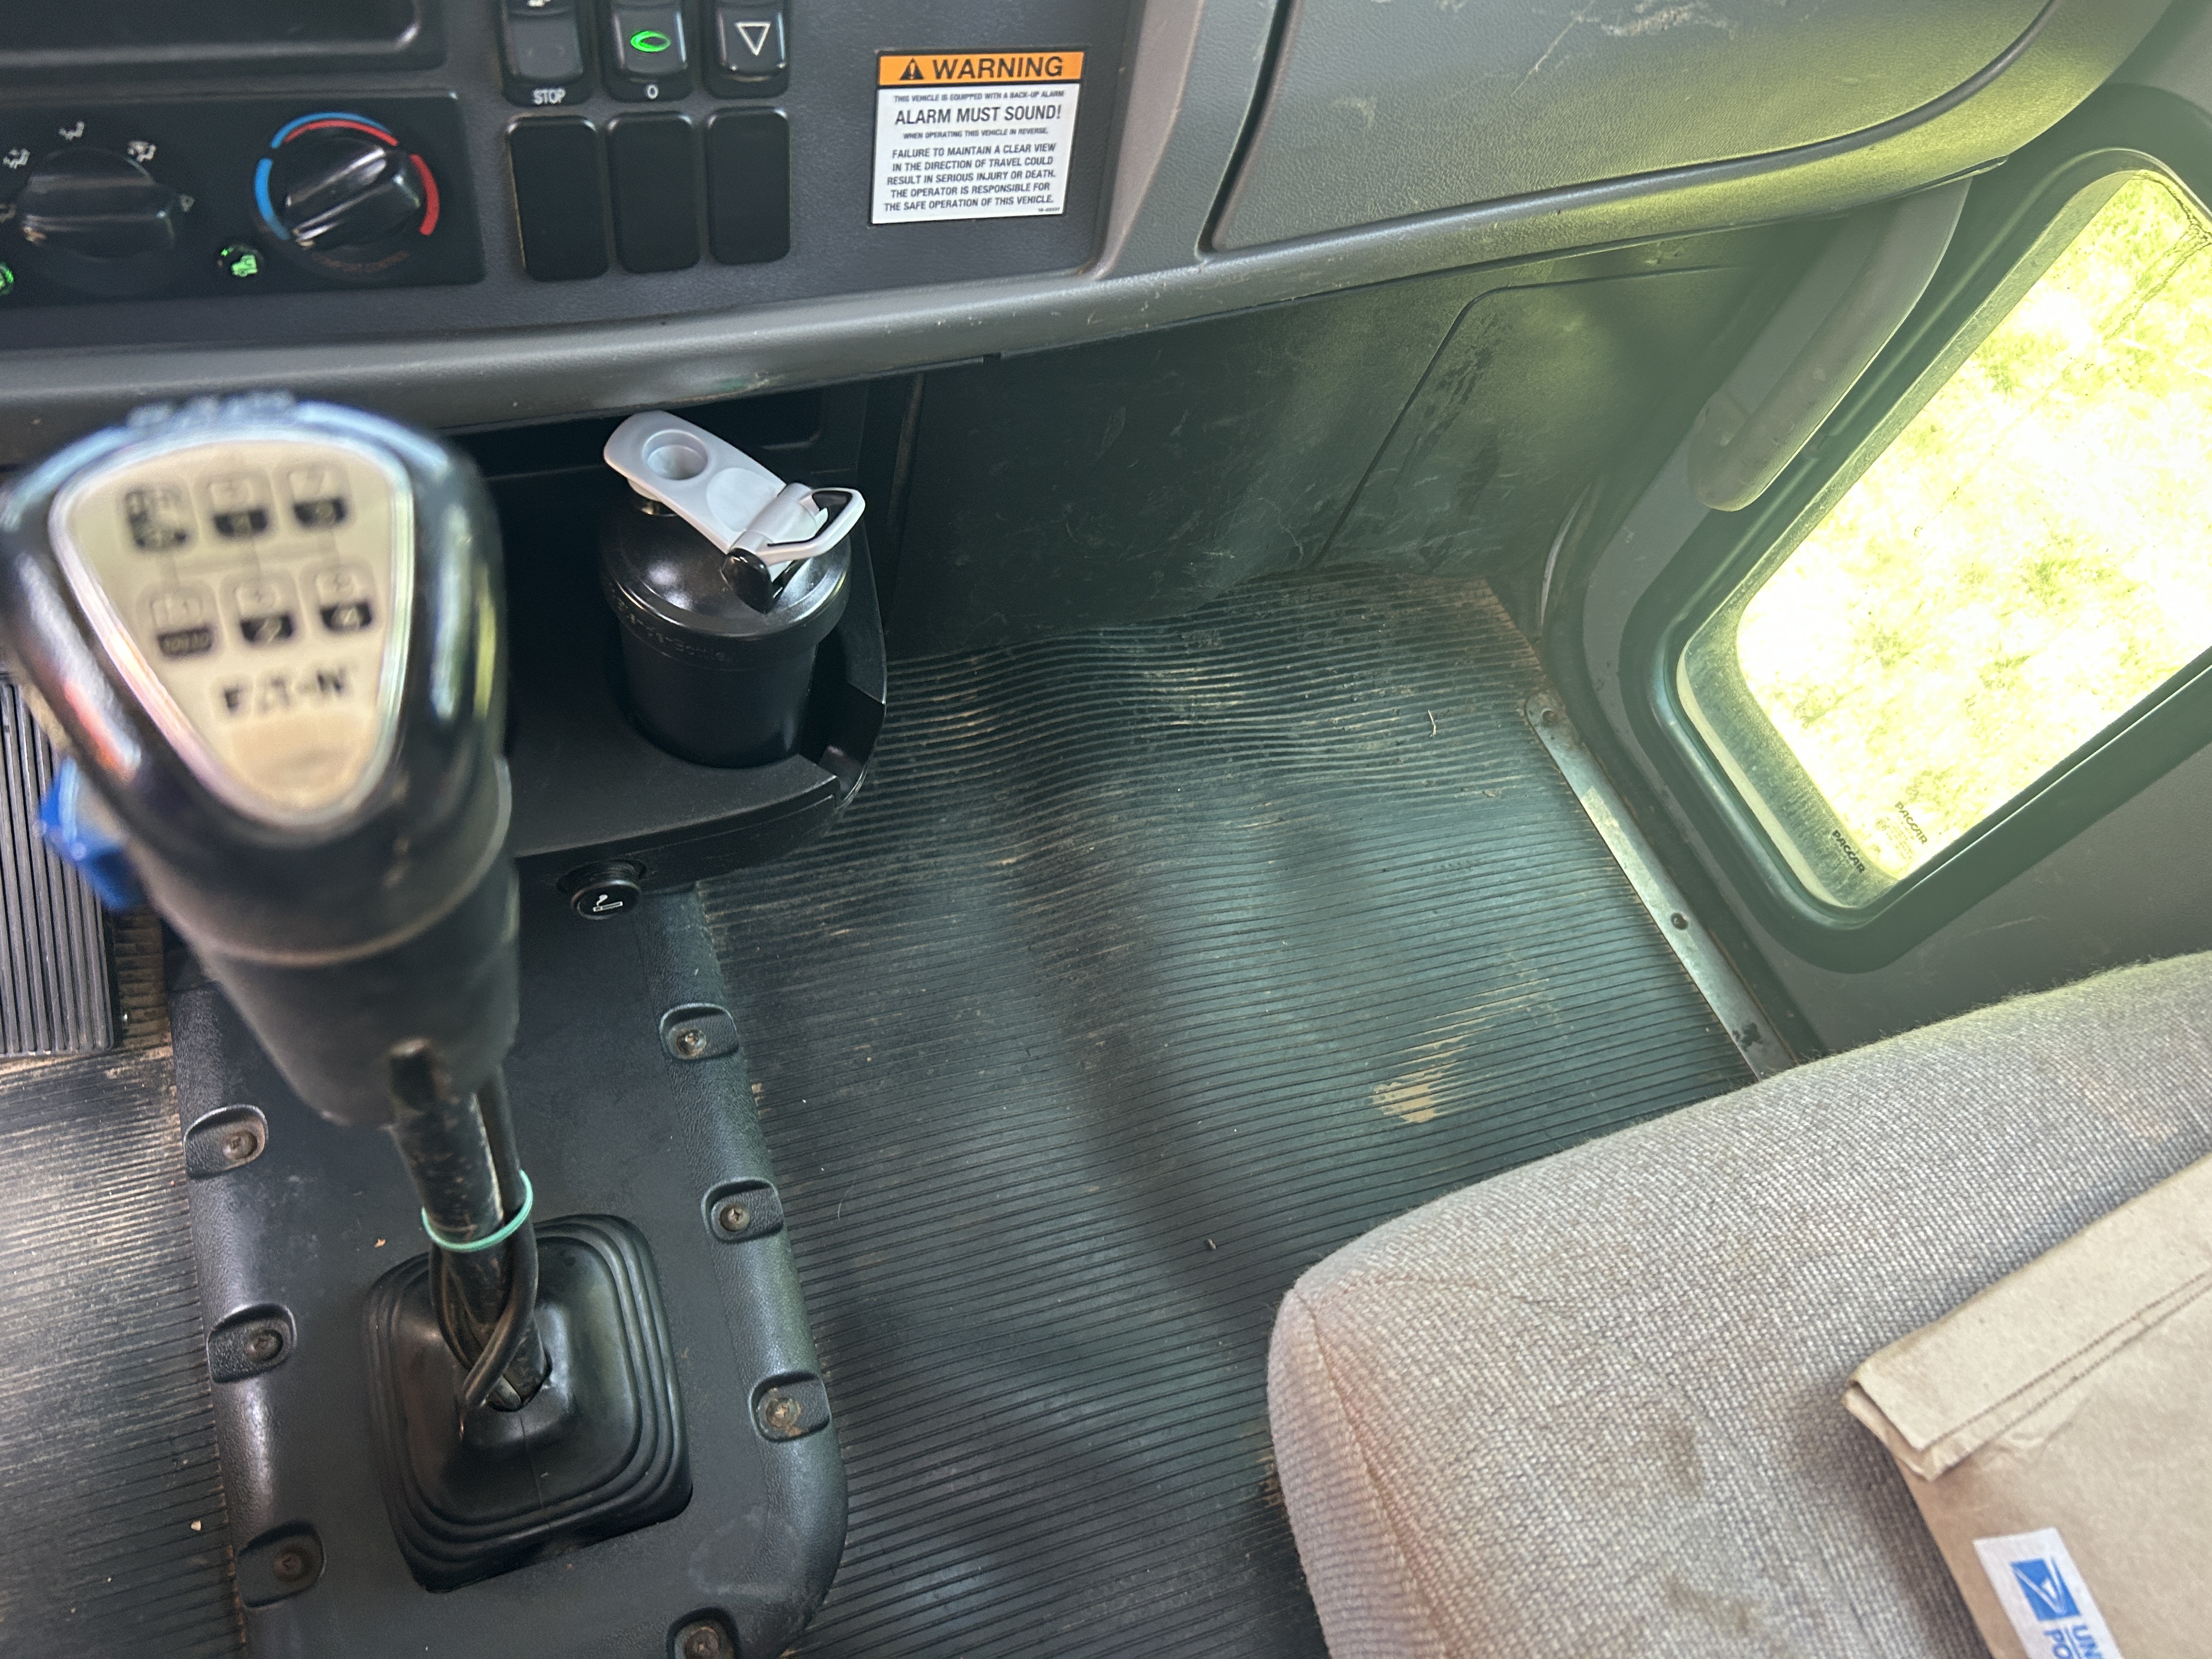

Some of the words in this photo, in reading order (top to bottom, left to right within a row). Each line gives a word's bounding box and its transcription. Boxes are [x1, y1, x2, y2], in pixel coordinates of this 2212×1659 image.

[933, 57, 1063, 80] WARNING
[533, 88, 566, 105] STOP
[895, 108, 951, 125] ALARM
[957, 106, 1000, 123] MUST
[1005, 105, 1061, 120] SOUND!
[892, 148, 930, 159] FAILURE
[933, 148, 944, 156] TO
[947, 145, 991, 156] MAINTAIN
[994, 145, 1001, 154] A
[1003, 144, 1031, 154] CLEAR
[1034, 143, 1057, 152] VIEW
[893, 163, 902, 172] IN
[905, 162, 922, 171] THE
[924, 160, 972, 170] DIRECTION
[975, 159, 985, 168] OF
[988, 158, 1022, 167] TRAVEL
[1025, 156, 1053, 165] COULD
[887, 176, 921, 185] RESULT
[923, 174, 933, 183] IN
[935, 173, 973, 183] SERIOUS
[977, 172, 1008, 181] INJURY
[1025, 170, 1056, 178] DEATH.
[891, 189, 907, 198] THE
[911, 187, 958, 196] OPERATOR
[960, 187, 968, 195] IS
[972, 184, 1031, 194] RESPONSIBLE
[1033, 183, 1049, 191] FOR
[884, 202, 901, 211] THE
[903, 201, 926, 210] SAFE
[929, 199, 978, 210] OPERATION
[981, 199, 992, 207] OF
[995, 198, 1014, 206] THIS
[1017, 195, 1053, 205] VEHICLE.
[1894, 801, 1928, 845] PACCAR
[1831, 829, 1865, 874] PACCAR
